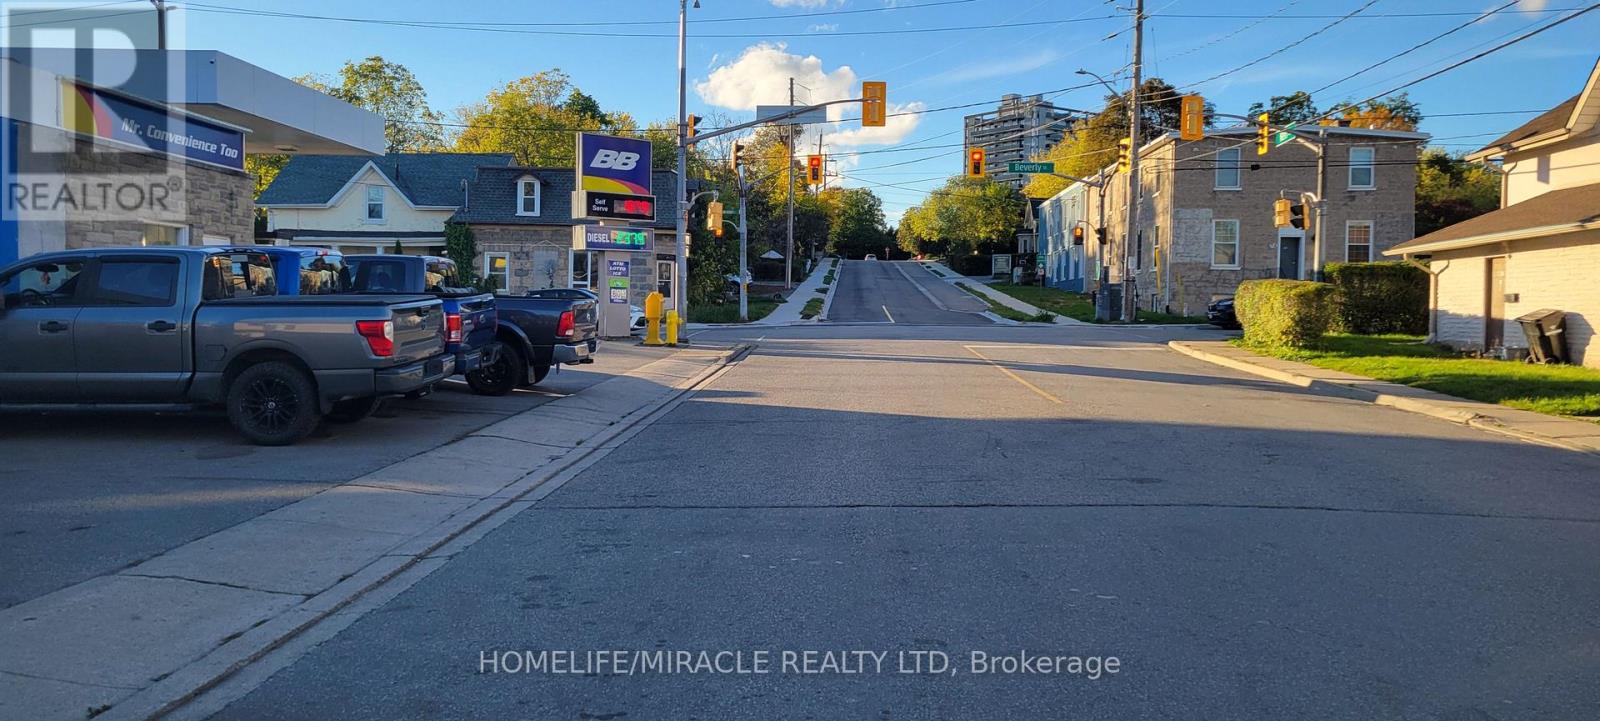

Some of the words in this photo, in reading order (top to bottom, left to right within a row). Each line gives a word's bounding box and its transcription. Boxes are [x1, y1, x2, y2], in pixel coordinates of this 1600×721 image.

[121, 117, 142, 135] Mr.
[147, 124, 217, 154] Convenience
[220, 143, 239, 159] Too
[590, 149, 640, 171] BB
[1014, 164, 1042, 173] Beverly
[592, 204, 609, 212] Serve
[587, 232, 610, 243] DIESEL
